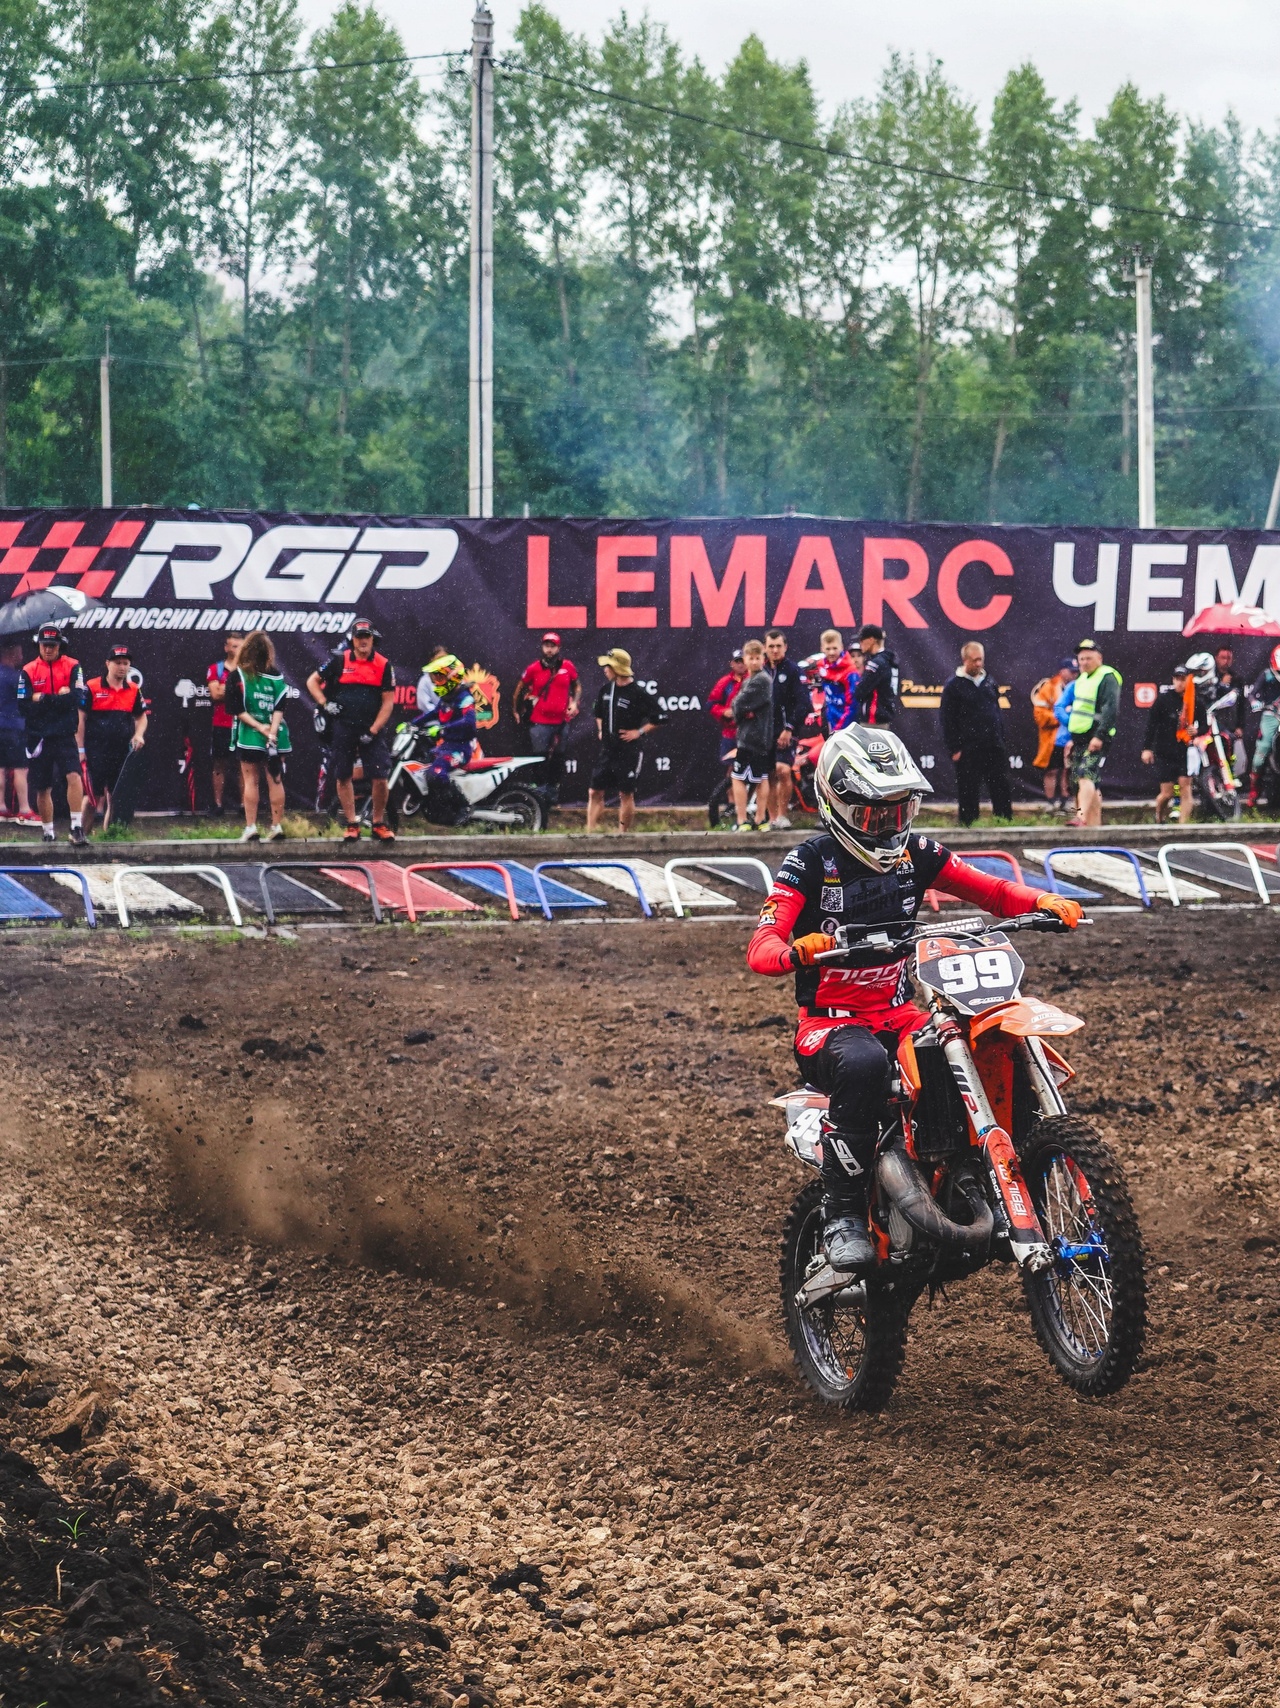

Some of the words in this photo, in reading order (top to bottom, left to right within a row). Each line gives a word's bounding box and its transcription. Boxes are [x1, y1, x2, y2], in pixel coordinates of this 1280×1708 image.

[111, 520, 459, 603] RGP
[526, 535, 1014, 631] LEMARC
[115, 607, 202, 630] РОССИИ
[197, 609, 224, 631] ПО
[225, 609, 357, 634] МОТОКРОССУ
[178, 760, 186, 774] 7
[565, 759, 577, 773] 11
[655, 757, 671, 771] 12
[920, 755, 935, 769] 15
[1008, 755, 1023, 769] 16
[938, 951, 1015, 994] 99
